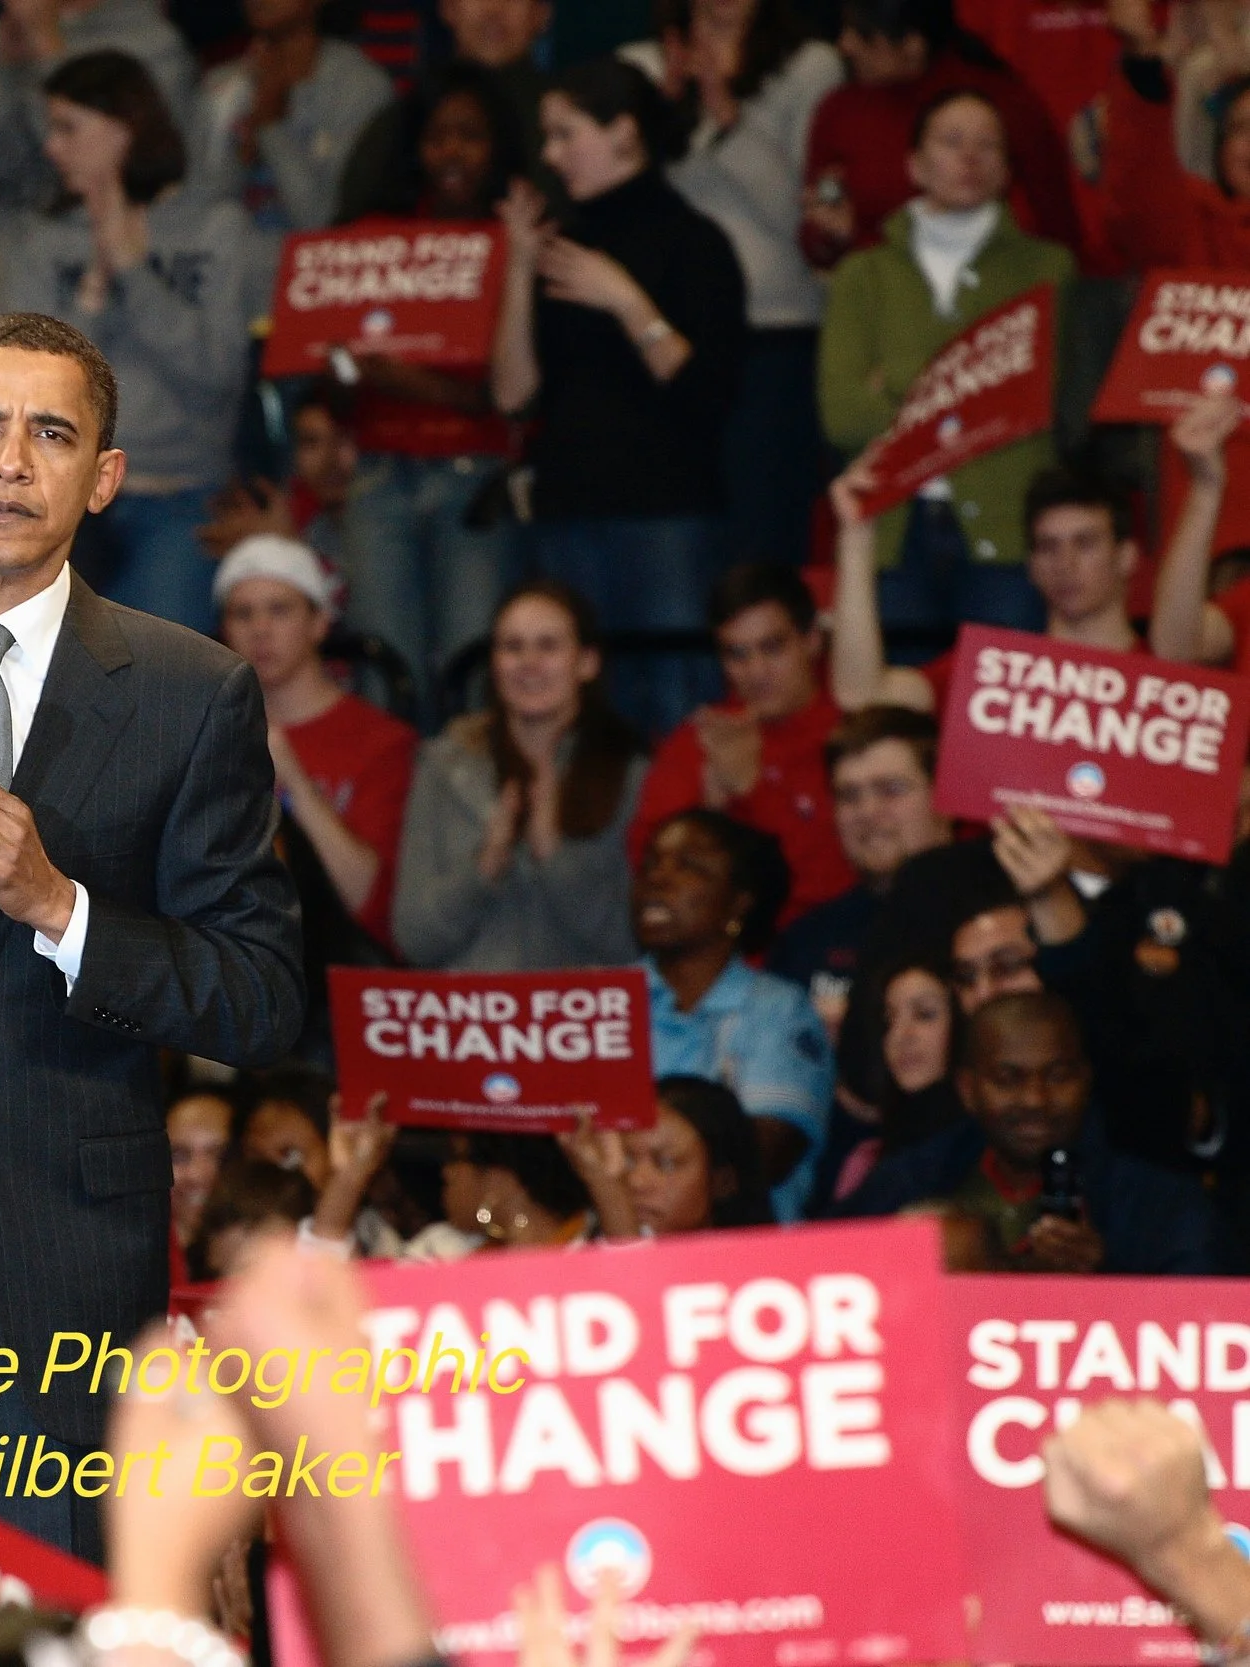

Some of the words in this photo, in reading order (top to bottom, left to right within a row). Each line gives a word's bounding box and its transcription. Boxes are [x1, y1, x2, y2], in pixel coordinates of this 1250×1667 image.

[413, 231, 493, 262] FOR
[286, 260, 485, 311] CHANGE
[976, 646, 1128, 706] STAND
[1134, 673, 1231, 727] FOR
[966, 685, 1225, 776] CHANGE
[360, 987, 520, 1023] STAND
[530, 986, 631, 1020] FOR
[363, 1018, 635, 1064] CHANGE
[358, 1291, 639, 1392] TAND
[662, 1270, 885, 1370] FOR
[390, 1358, 892, 1501] HANGE
